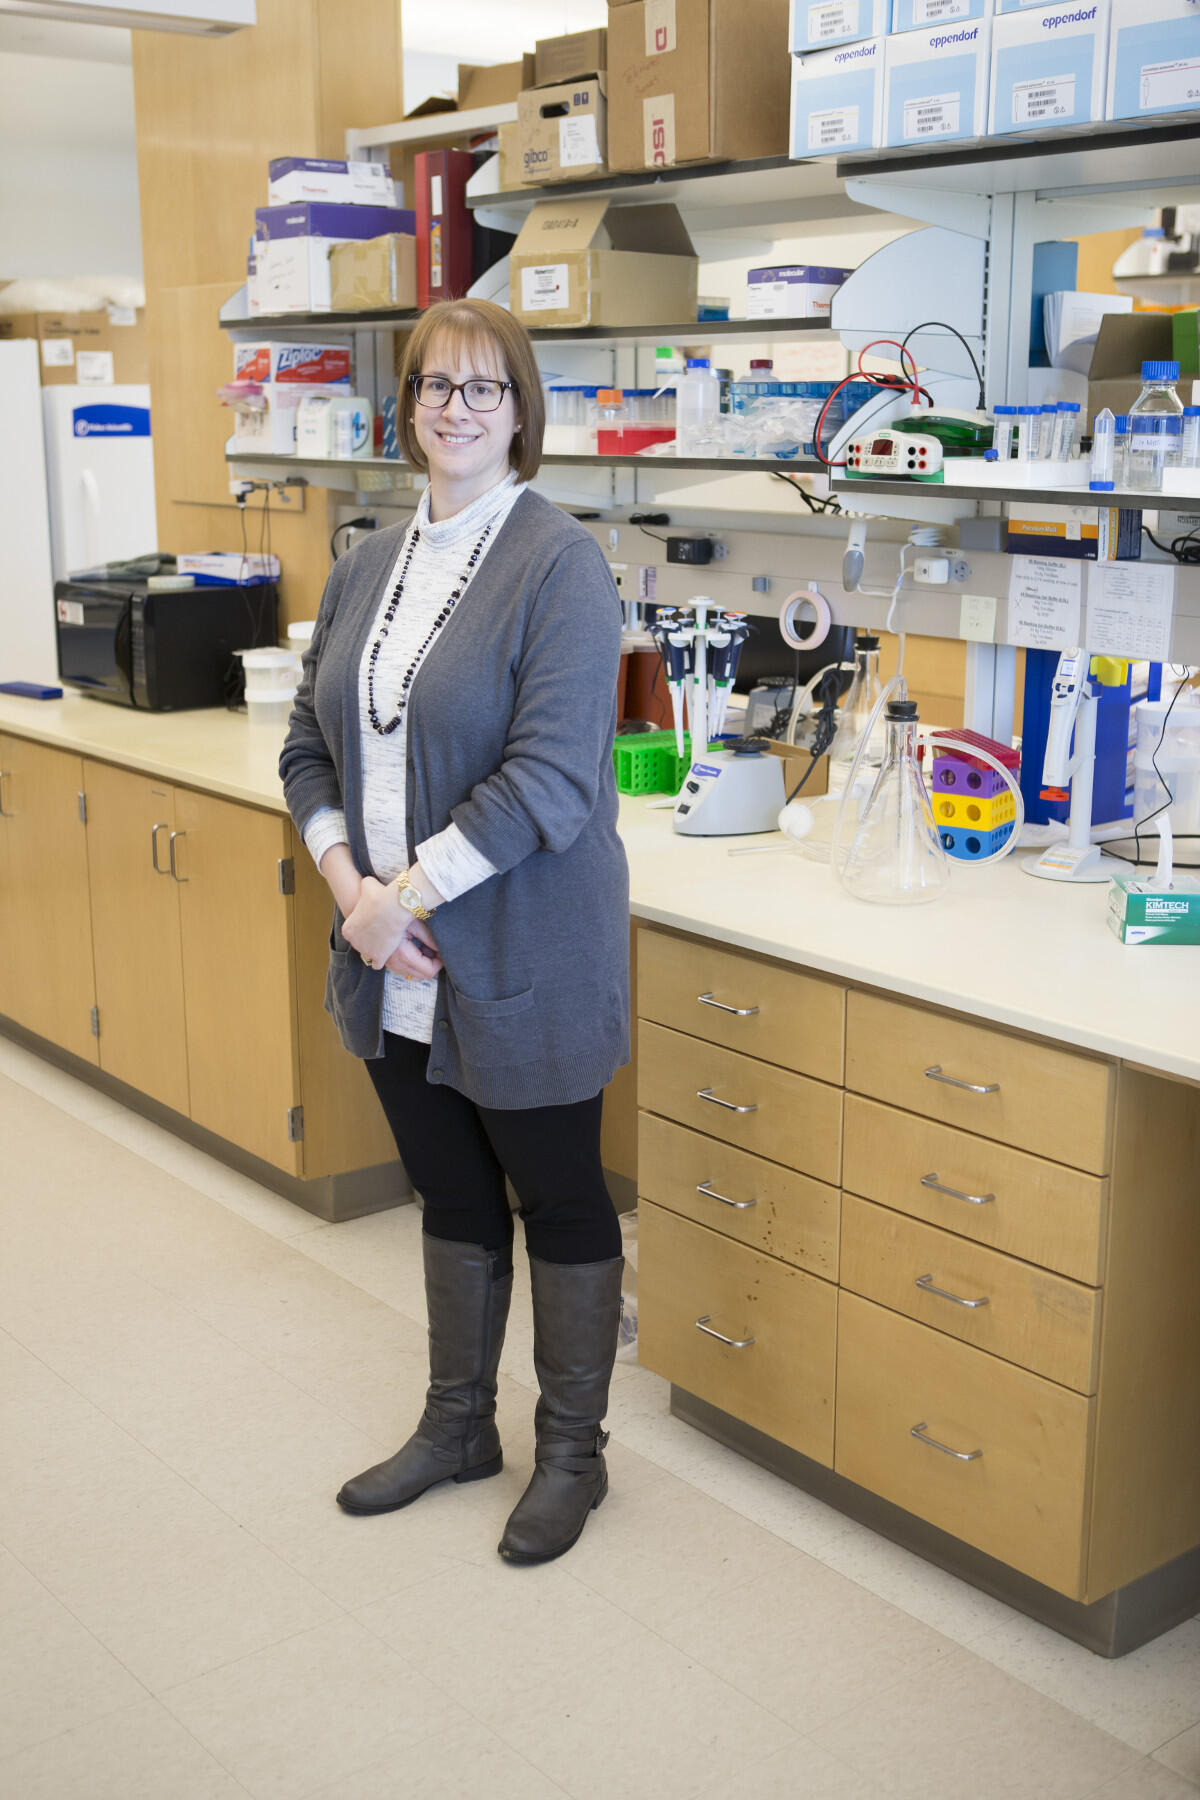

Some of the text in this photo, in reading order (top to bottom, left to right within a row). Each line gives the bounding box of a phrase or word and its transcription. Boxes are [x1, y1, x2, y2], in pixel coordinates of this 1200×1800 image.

[1042, 7, 1097, 29] eppendorf
[929, 28, 979, 48] eppendorf
[834, 44, 877, 63] eppendorf
[523, 148, 549, 169] gibco
[277, 346, 323, 371] Ziploc
